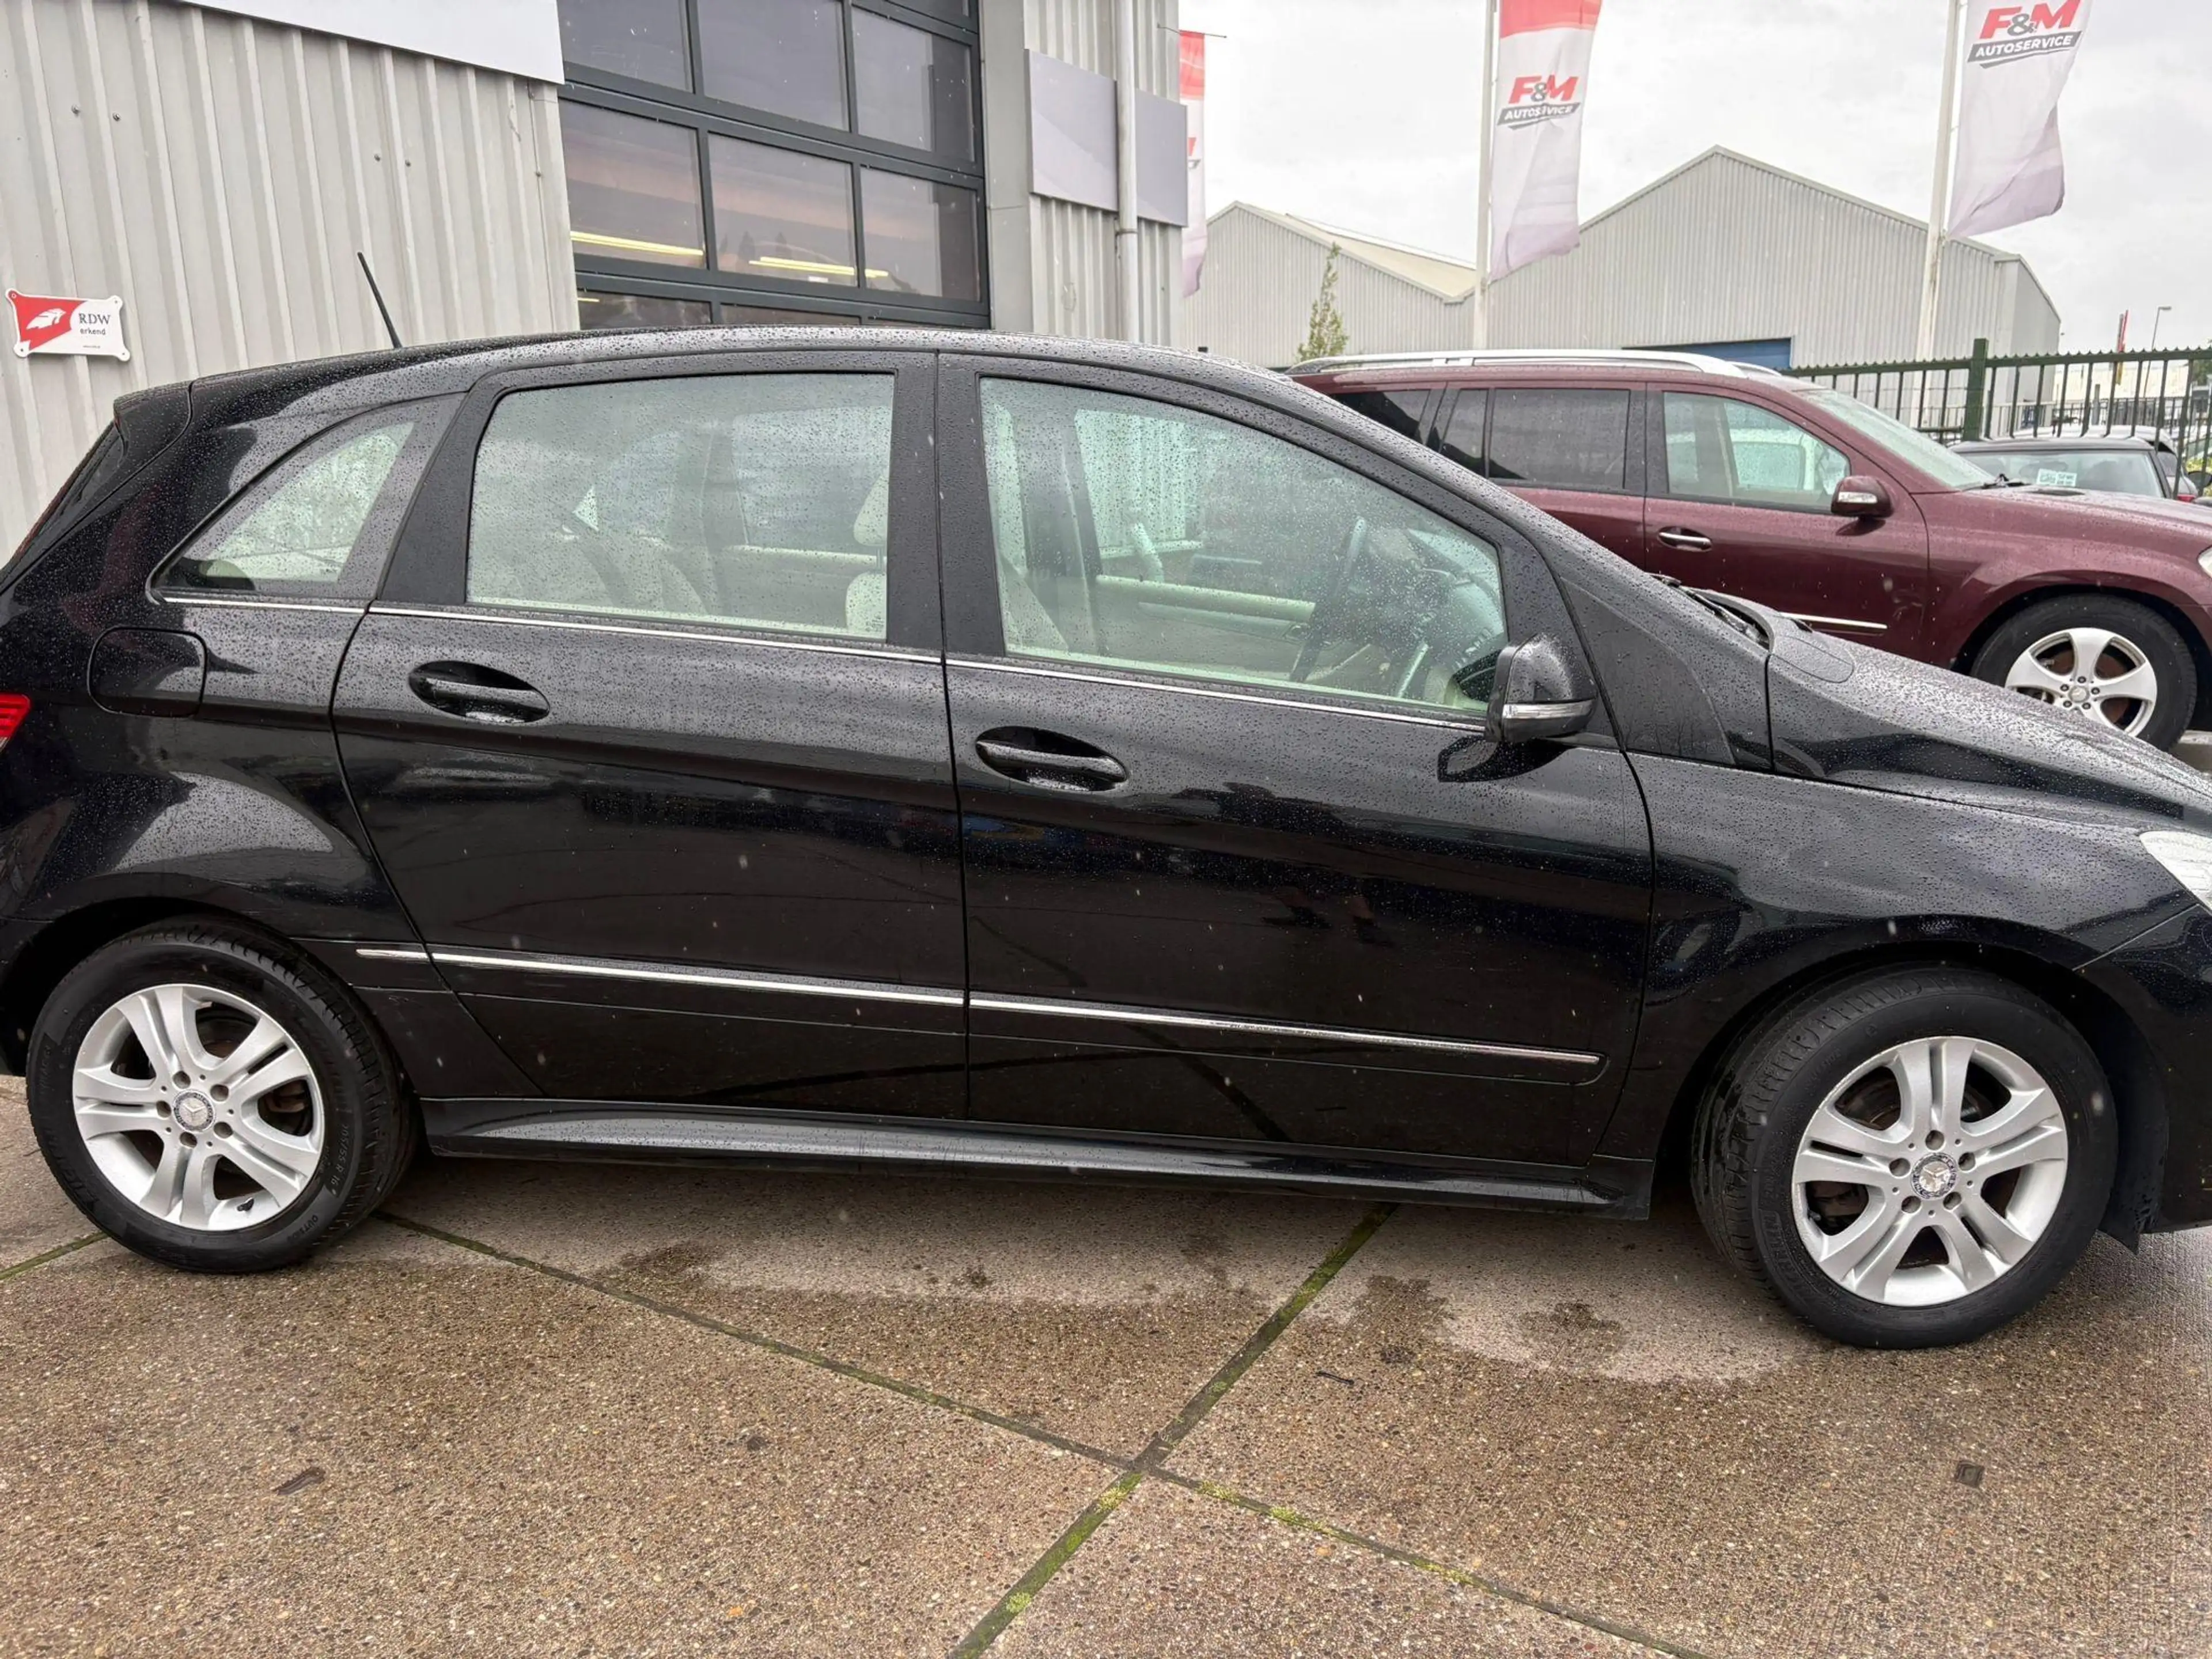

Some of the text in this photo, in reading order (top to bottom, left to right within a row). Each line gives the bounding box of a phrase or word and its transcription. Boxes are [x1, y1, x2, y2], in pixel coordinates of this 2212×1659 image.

[1979, 0, 2081, 39] F&M
[1975, 35, 2074, 58] AUTOSERVICE
[1508, 74, 1579, 104] F&M
[78, 313, 111, 325] RDW
[79, 327, 106, 335] erkend
[336, 1164, 344, 1173] R
